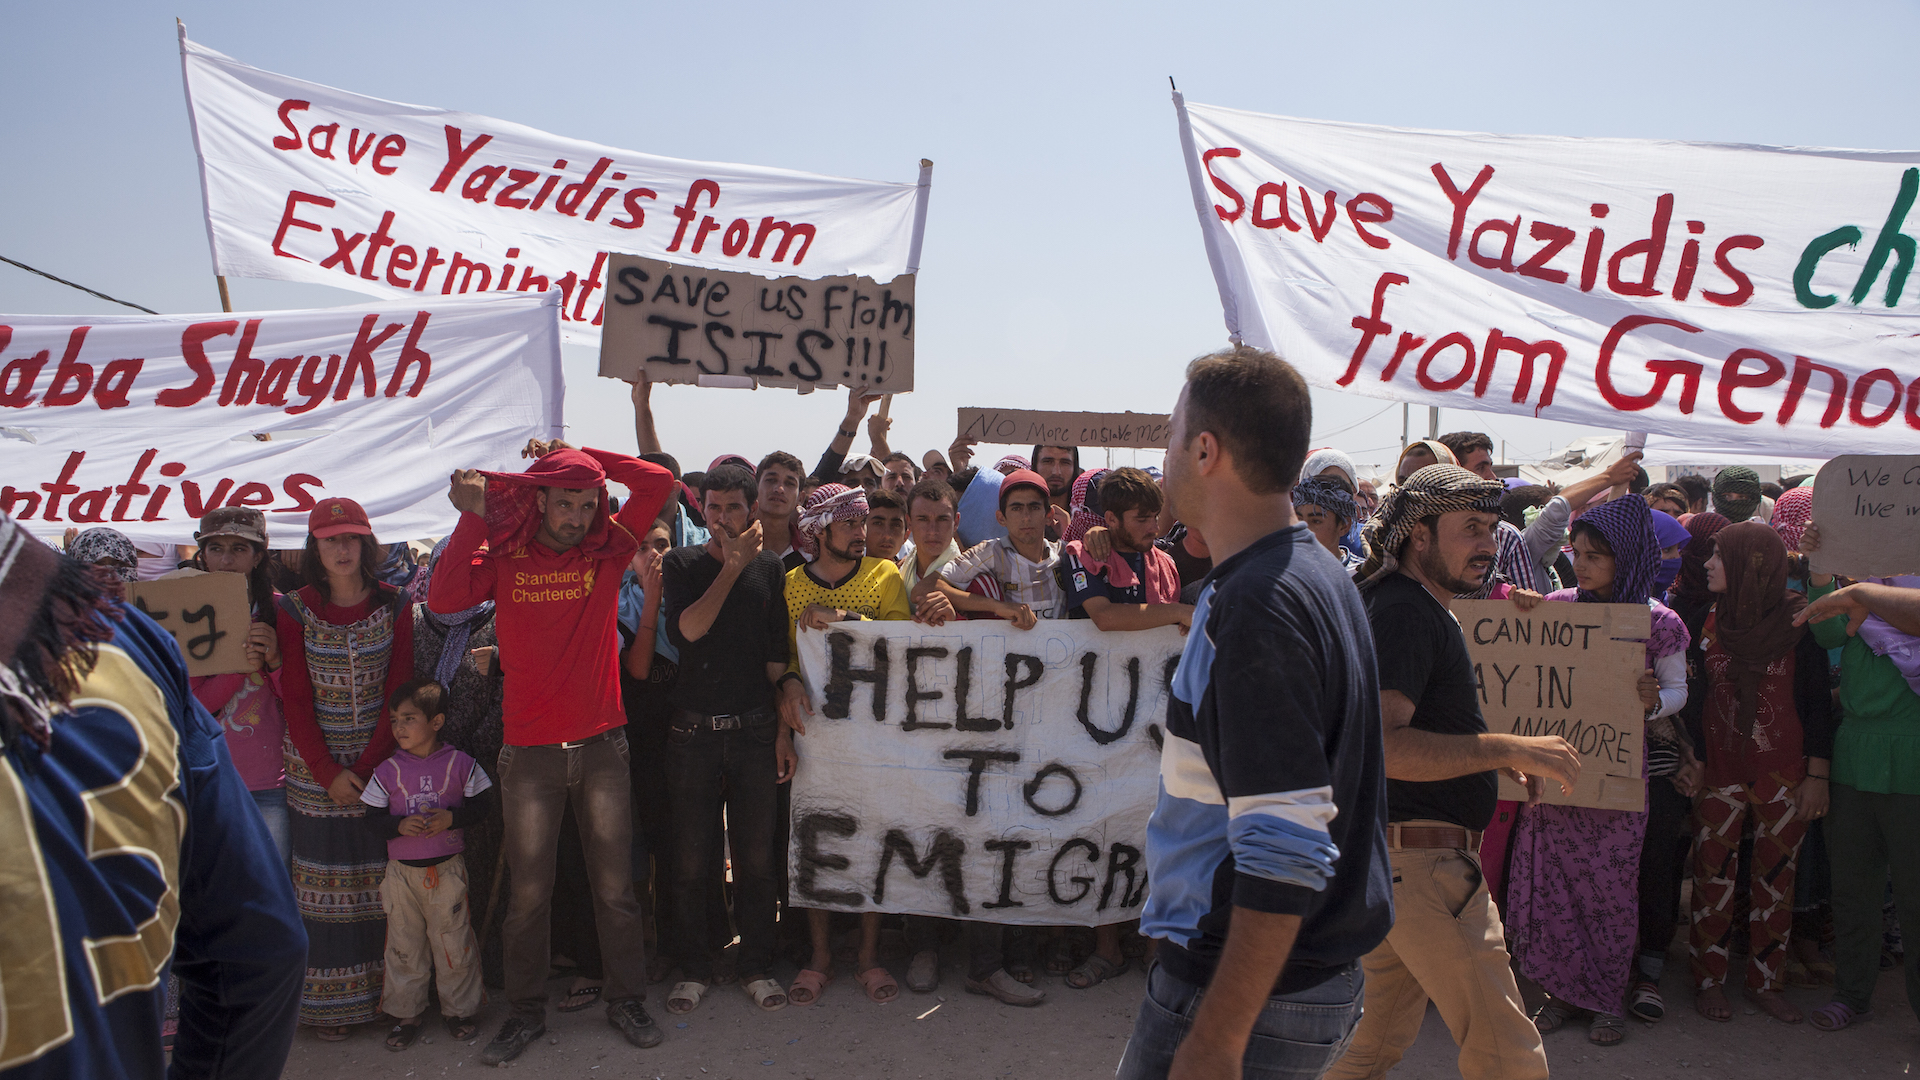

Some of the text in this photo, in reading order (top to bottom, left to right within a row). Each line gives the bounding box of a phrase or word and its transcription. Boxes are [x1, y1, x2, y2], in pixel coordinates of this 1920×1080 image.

[273, 99, 816, 266] Save Yazidis from
[1202, 147, 1920, 308] Save Yazidis ch
[272, 189, 608, 326] Exterminat
[646, 314, 889, 384] ISIS!!!
[1336, 271, 1568, 418] from
[965, 413, 1016, 437] NO
[1848, 466, 1891, 487] We
[1854, 493, 1895, 518] live
[511, 585, 583, 603] Chartered
[514, 569, 582, 586] Standard
[1473, 617, 1602, 650] CAN NOT
[822, 630, 1045, 732] HELP
[1535, 664, 1576, 709] IN
[943, 750, 1082, 818] TO
